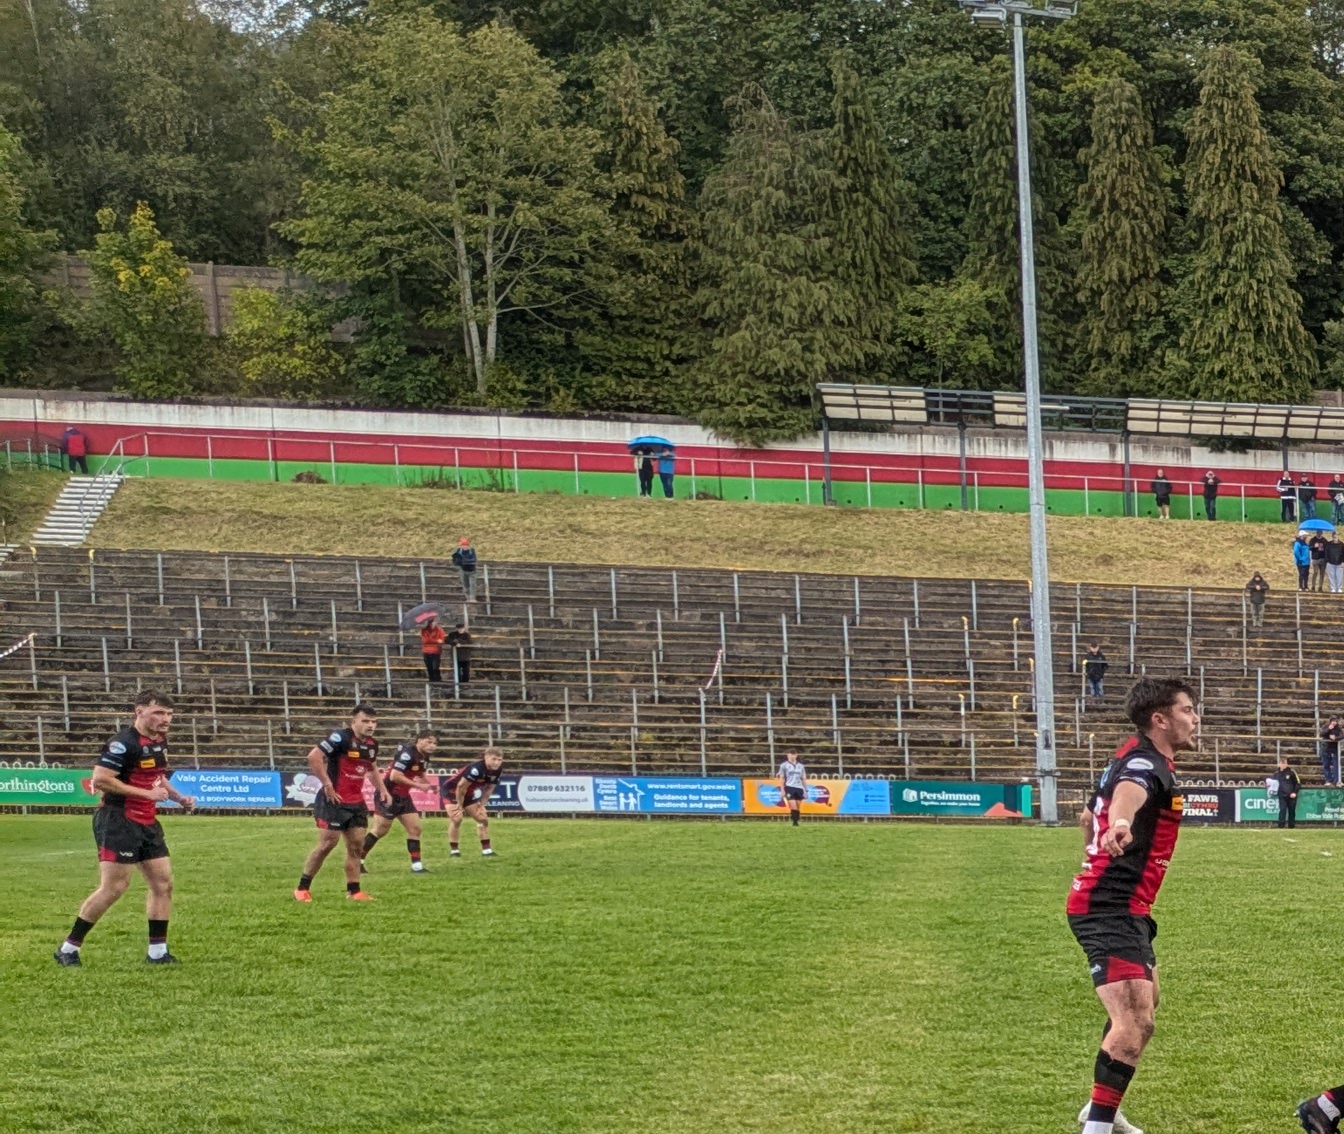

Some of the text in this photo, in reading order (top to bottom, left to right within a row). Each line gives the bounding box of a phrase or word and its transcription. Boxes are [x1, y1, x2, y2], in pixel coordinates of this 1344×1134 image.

[176, 774, 196, 782] Vale
[242, 776, 272, 784] Repair
[200, 784, 249, 793] Centre Ltd
[920, 791, 980, 802] Persimmon
[1187, 794, 1218, 802] FAWR
